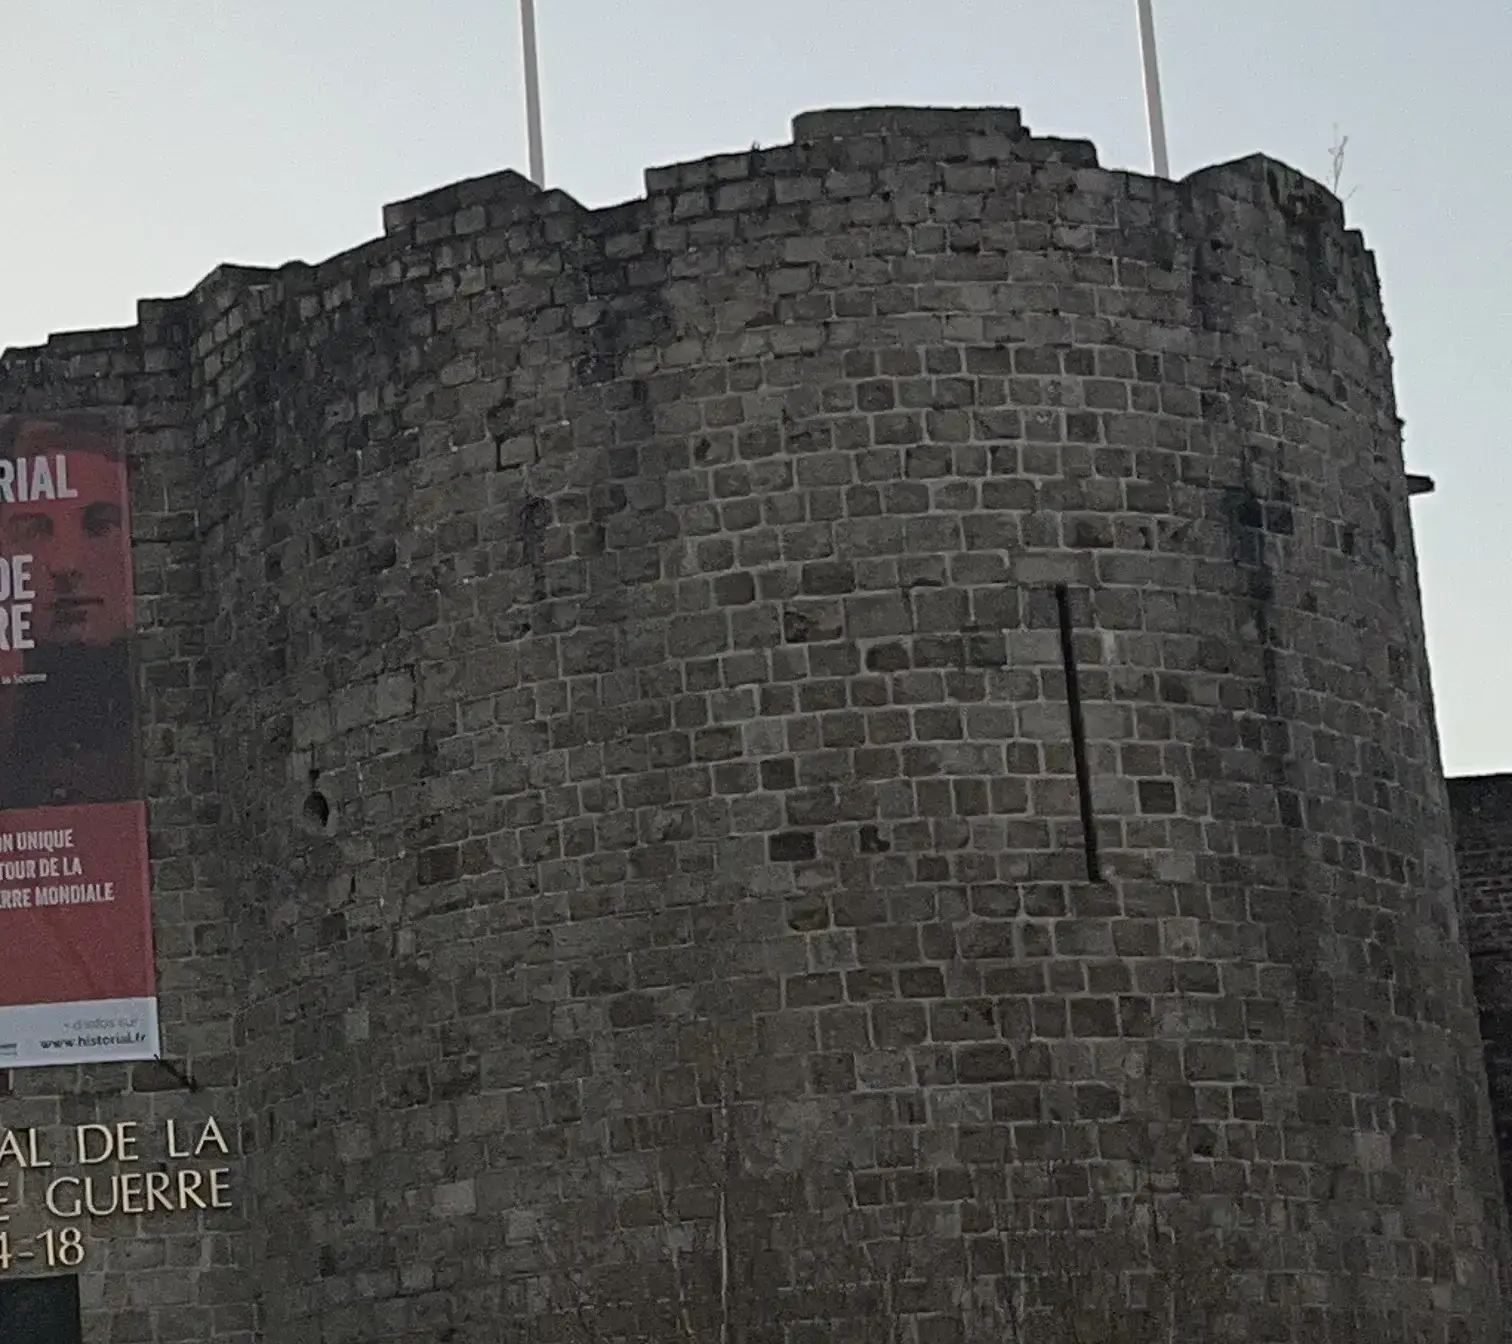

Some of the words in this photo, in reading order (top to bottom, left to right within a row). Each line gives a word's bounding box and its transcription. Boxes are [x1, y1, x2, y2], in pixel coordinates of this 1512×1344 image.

[17, 829, 74, 851] UNIQUE
[39, 858, 59, 877] DE
[62, 856, 82, 876] LA
[35, 882, 115, 907] MONDIALE
[40, 1031, 147, 1050] www.historial.fr
[76, 1121, 140, 1166] DE
[166, 1115, 229, 1158] LA
[46, 1167, 233, 1219] GUERRE
